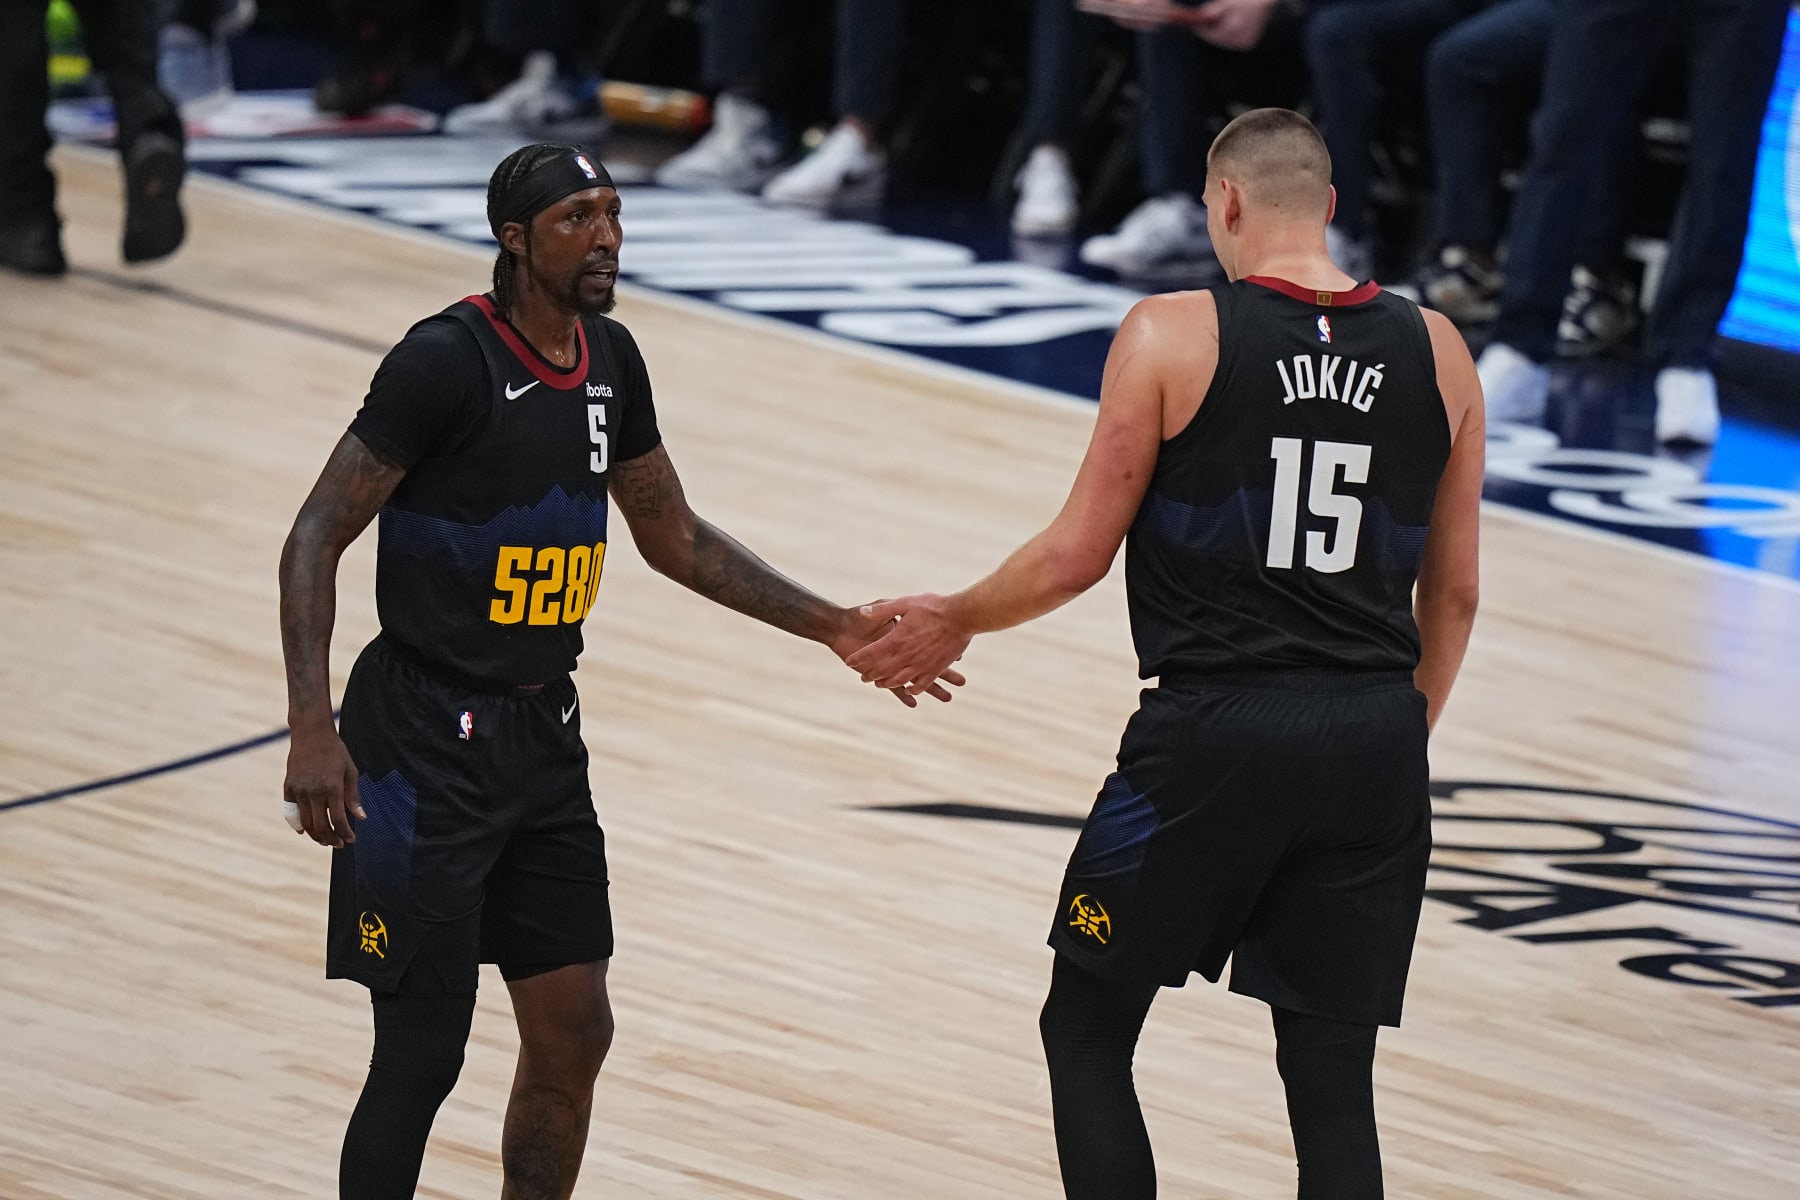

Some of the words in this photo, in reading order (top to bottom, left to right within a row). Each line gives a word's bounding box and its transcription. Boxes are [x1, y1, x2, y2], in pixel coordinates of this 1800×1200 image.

[585, 381, 613, 397] ibotta
[1276, 354, 1385, 413] JOKIĆ
[587, 404, 608, 474] 5
[1266, 437, 1372, 573] 15
